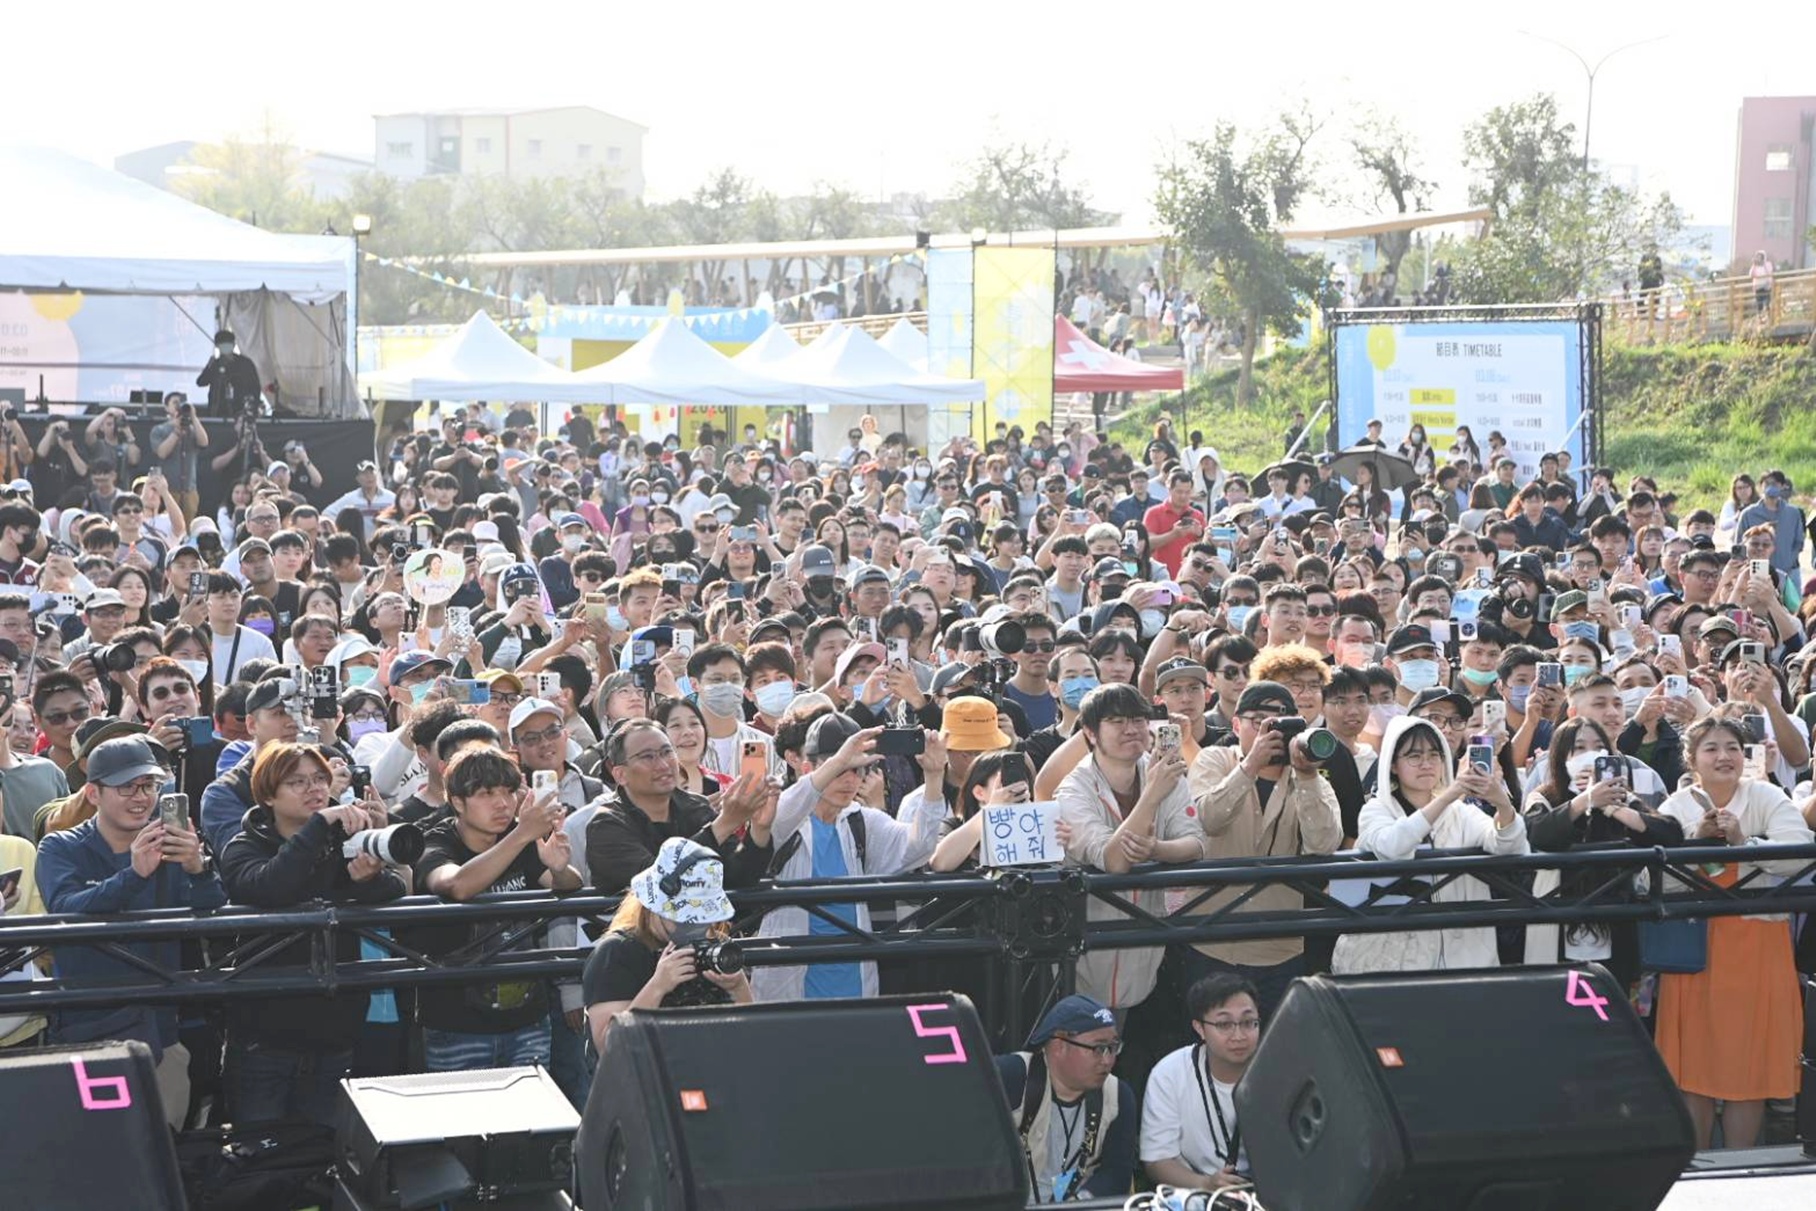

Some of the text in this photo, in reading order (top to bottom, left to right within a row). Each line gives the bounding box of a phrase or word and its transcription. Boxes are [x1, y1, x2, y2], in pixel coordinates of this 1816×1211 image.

[1463, 343, 1502, 358] TIMETABLE
[1566, 970, 1609, 1021] 4
[906, 1003, 967, 1064] 5
[71, 1055, 132, 1110] 6
